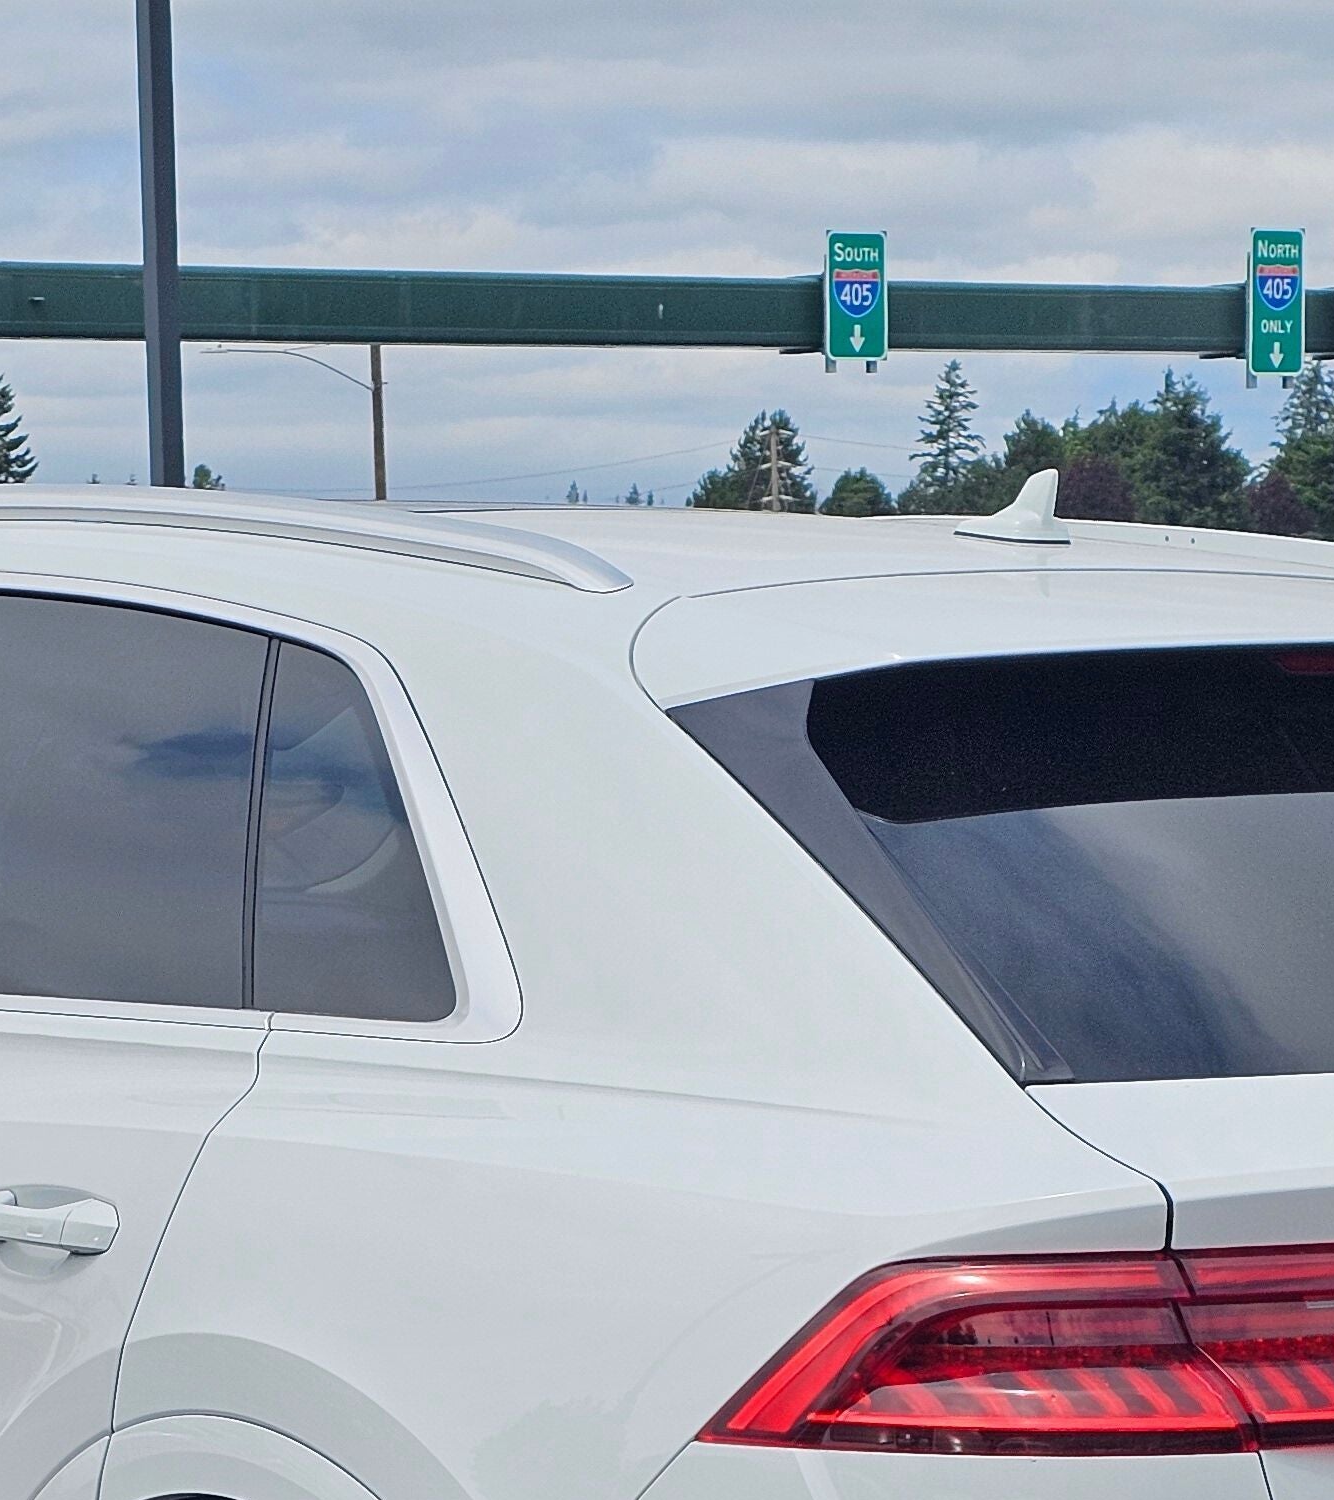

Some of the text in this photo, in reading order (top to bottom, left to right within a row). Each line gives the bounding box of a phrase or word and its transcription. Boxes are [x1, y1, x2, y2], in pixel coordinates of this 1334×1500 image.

[834, 243, 879, 262] SOUTH
[1258, 240, 1299, 259] NORTH
[840, 283, 873, 306] 405
[1263, 279, 1292, 299] 405
[1261, 319, 1293, 333] ONLY
